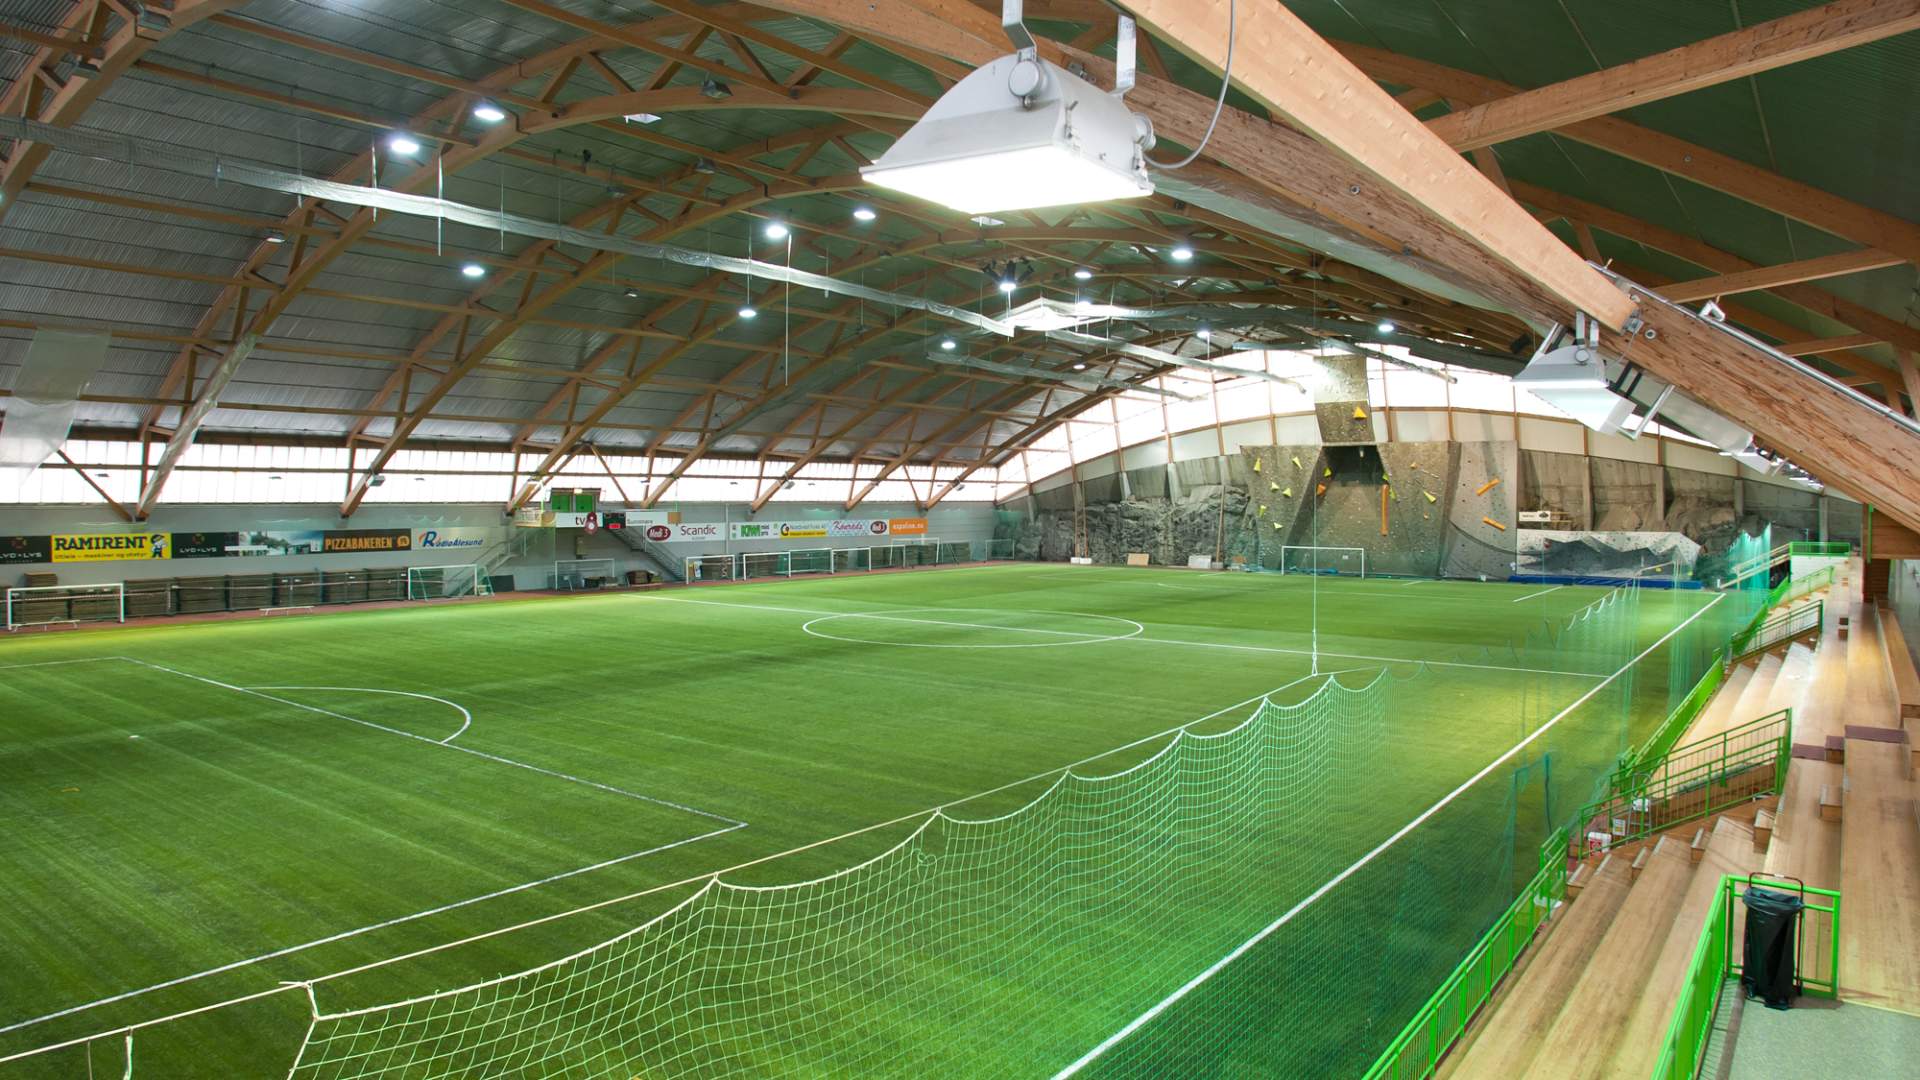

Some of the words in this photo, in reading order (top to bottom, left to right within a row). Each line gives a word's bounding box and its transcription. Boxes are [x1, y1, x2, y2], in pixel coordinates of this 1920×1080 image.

[680, 525, 716, 536] Scandic
[54, 535, 148, 551] RAMIRENT
[325, 537, 393, 550] PIZZABAKEREN
